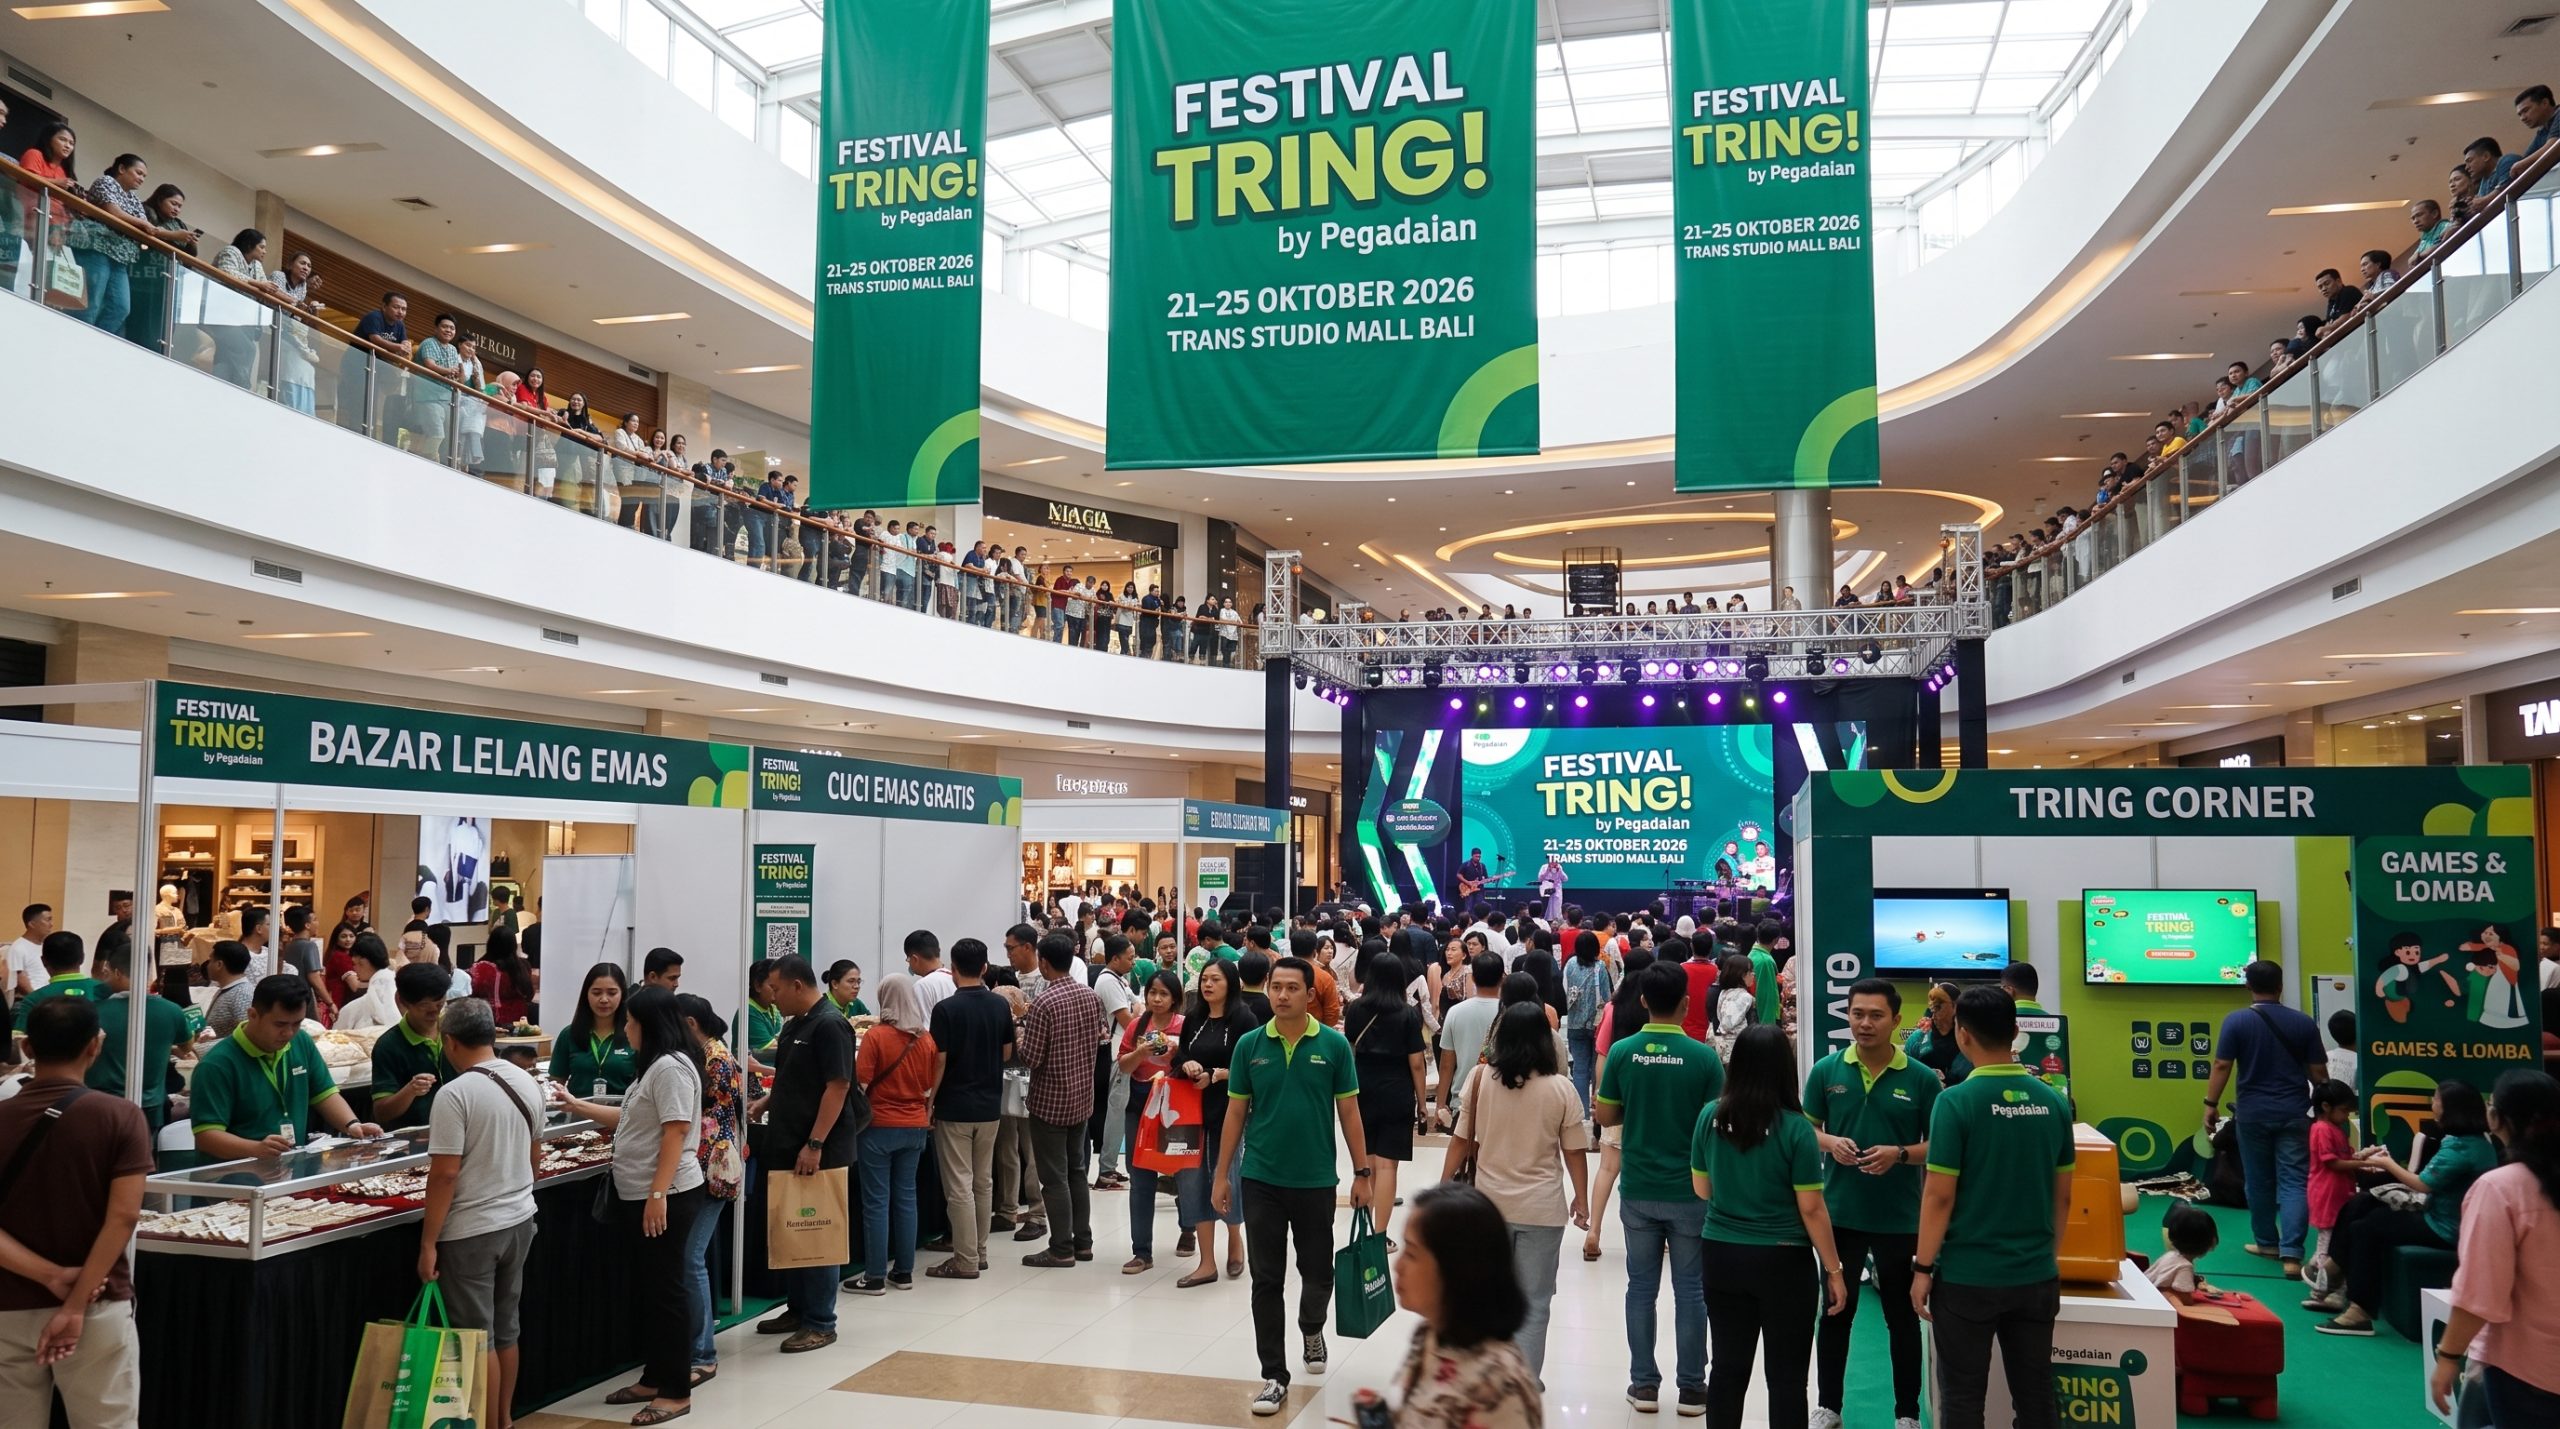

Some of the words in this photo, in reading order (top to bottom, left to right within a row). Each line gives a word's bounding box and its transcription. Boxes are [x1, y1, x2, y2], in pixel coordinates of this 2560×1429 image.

[1175, 51, 1464, 134] FESTIVAL
[1693, 77, 1846, 118] FESTIVAL
[838, 129, 968, 166] FESTIVAL
[1682, 110, 1860, 166] TRING!
[1156, 110, 1487, 222] TRING!
[1748, 168, 1766, 185] by
[1770, 160, 1855, 183] Pegadaian
[829, 159, 977, 210] TRING!
[881, 212, 897, 229] by
[1735, 217, 1815, 237] OKTOBER
[1818, 214, 1860, 232] 2026
[1278, 226, 1311, 259] by
[1321, 214, 1477, 255] Pegadaian
[1684, 244, 1730, 259] TRANS
[1732, 241, 1784, 257] STUDIO
[1787, 239, 1825, 254] MALL
[1828, 236, 1861, 251] BALI
[870, 256, 936, 275] OKTOBER
[939, 254, 974, 270] 2026
[826, 281, 864, 295] TRANS
[866, 278, 909, 293] STUDIO
[912, 276, 944, 290] MALL
[947, 274, 974, 288] BALI
[1257, 280, 1395, 313] OKTOBER
[1402, 275, 1475, 305] 2026
[1166, 327, 1245, 353] TRANS
[1250, 322, 1340, 348] STUDIO
[1346, 318, 1413, 344] MALL
[1420, 314, 1475, 340] BALI
[176, 698, 260, 723] FESTIVAL
[169, 719, 264, 751] TRING!
[203, 751, 216, 765] by
[309, 721, 442, 772] BAZAR
[452, 734, 581, 782] LELANG
[590, 747, 668, 788] EMAS
[762, 757, 799, 772] FESTIVAL
[1543, 749, 1682, 778] FESTIVAL
[760, 772, 801, 792] TRING!
[827, 771, 869, 802] CUCI
[874, 776, 920, 807] EMAS
[923, 781, 975, 811] GRATIS
[1536, 775, 1692, 816] TRING!
[2009, 786, 2134, 819] TRING
[2145, 786, 2316, 819] CORNER
[1595, 818, 1612, 833] by
[1615, 816, 1690, 833] Pegadaian
[1584, 838, 1650, 851] OKTOBER
[1652, 839, 1688, 851] 2026
[761, 853, 805, 864] FESTIVAL
[1546, 853, 1582, 863] TRANS
[1584, 853, 1623, 864] STUDIO
[1626, 853, 1657, 864] MALL
[1659, 853, 1684, 864] BALI
[2381, 851, 2479, 874] GAMES
[2485, 852, 2507, 874] &
[758, 865, 808, 879] TRING!
[2395, 880, 2495, 902] LOMBA
[2145, 921, 2194, 933] TRING!
[1632, 1053, 1684, 1065] Pegadaian
[2371, 1040, 2438, 1058] GAMES
[2443, 1042, 2457, 1058] &
[2462, 1043, 2532, 1060] LOMBA
[1991, 1103, 2050, 1118] Pegadaian
[2052, 1347, 2112, 1360] Pegadaian
